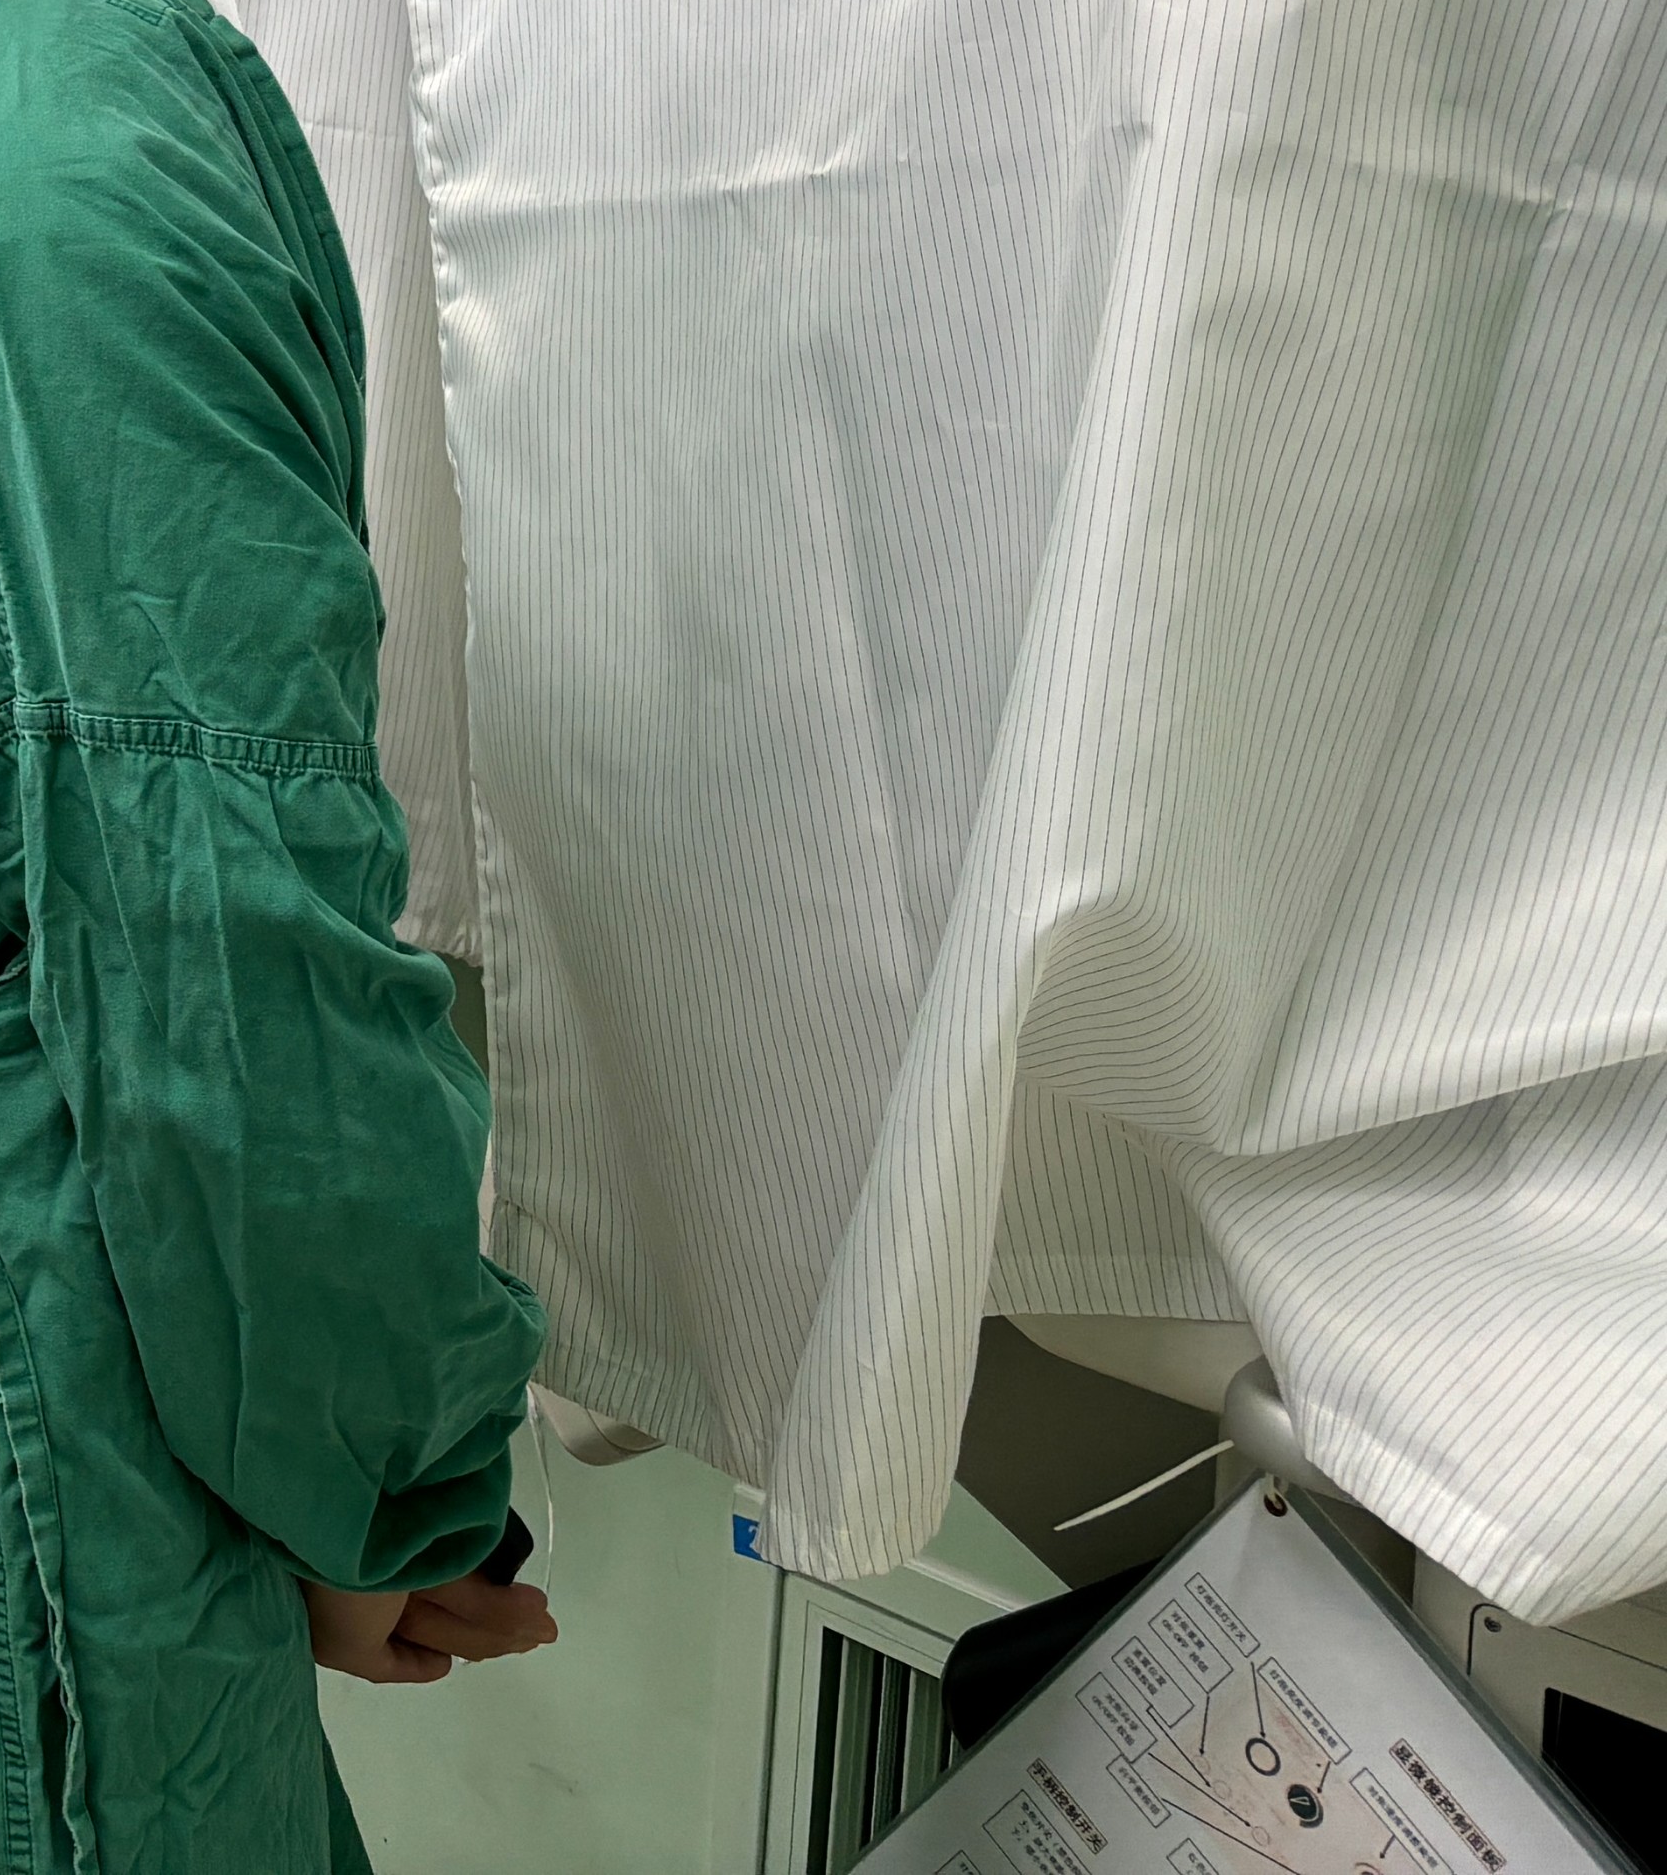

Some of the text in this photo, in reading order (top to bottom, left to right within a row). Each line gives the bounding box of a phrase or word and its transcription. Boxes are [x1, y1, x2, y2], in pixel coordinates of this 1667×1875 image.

[1027, 1759, 1108, 1852] 手柄控制开关
[1392, 1742, 1505, 1873] 显微镜控制面板
